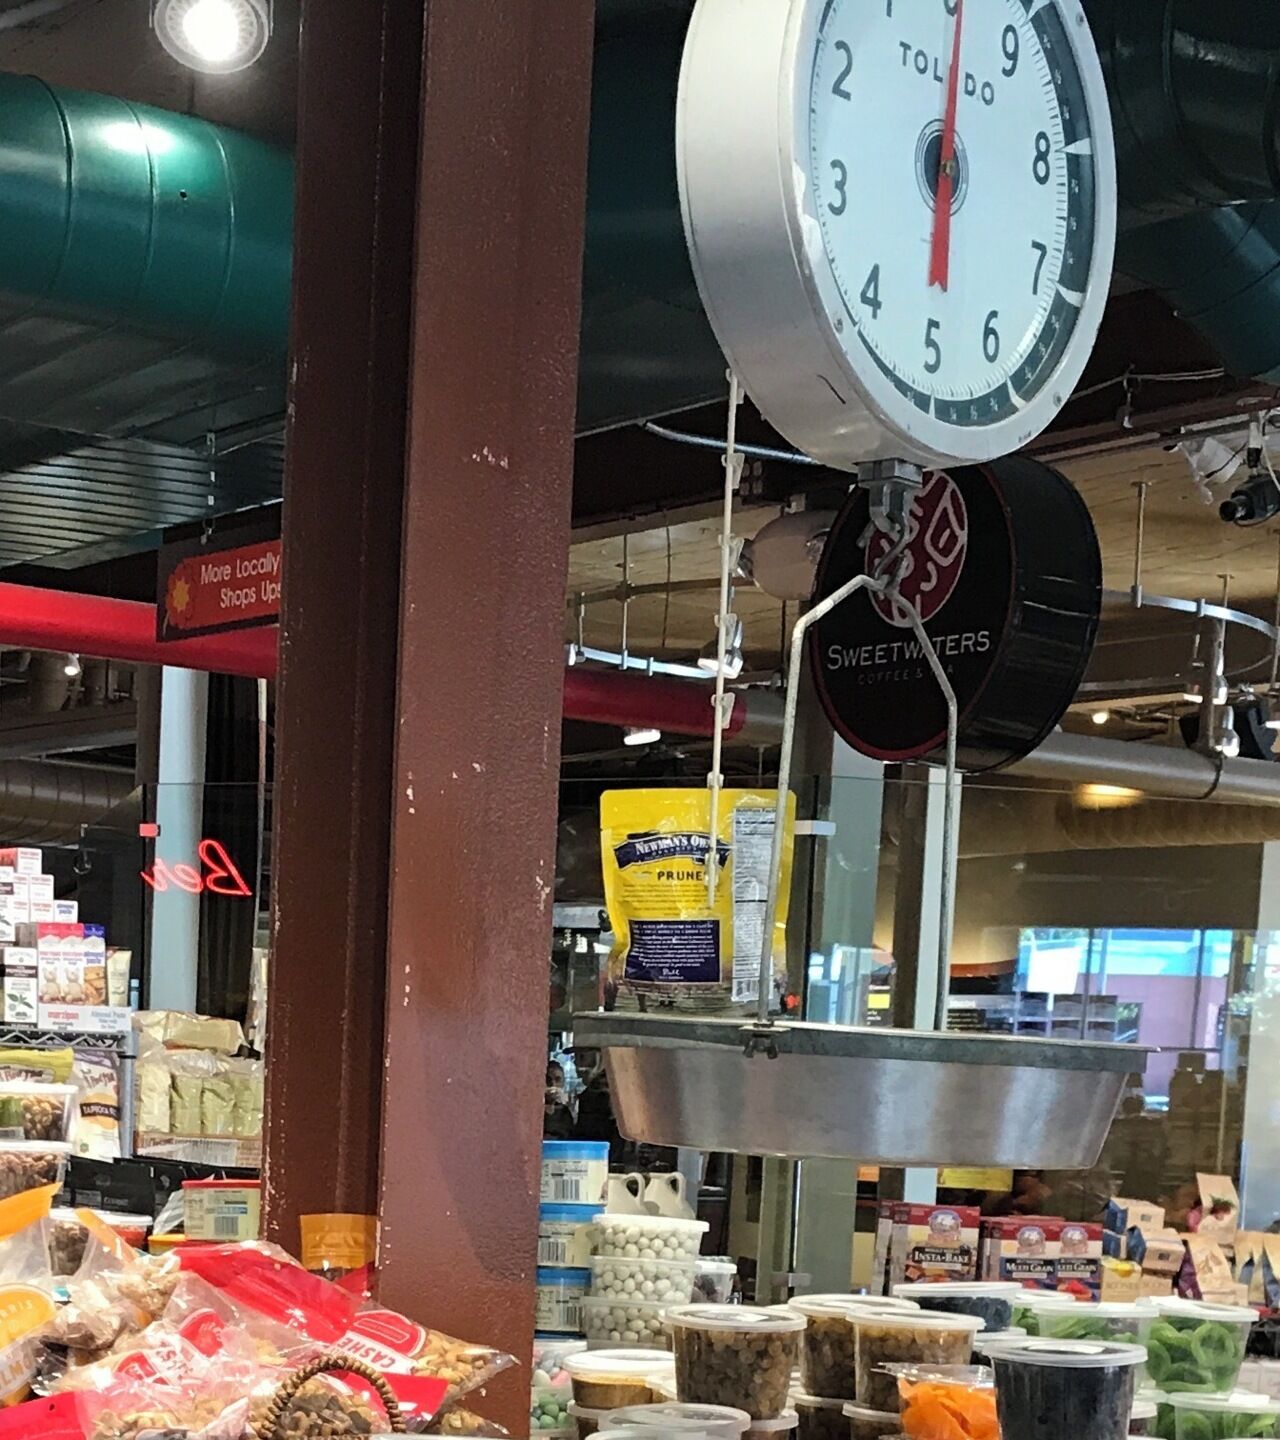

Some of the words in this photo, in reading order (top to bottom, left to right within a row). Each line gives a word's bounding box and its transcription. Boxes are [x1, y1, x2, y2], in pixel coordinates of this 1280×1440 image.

[832, 40, 853, 101] 2
[899, 41, 995, 105] TOLDO
[1001, 25, 1019, 77] 9
[1032, 131, 1050, 185] 8
[827, 159, 848, 216] 3
[860, 264, 883, 319] 4
[1031, 240, 1048, 295] 7
[924, 318, 941, 374] 5
[982, 309, 1000, 363] 6
[201, 563, 231, 585] More
[236, 551, 281, 579] Locally
[220, 585, 257, 609] Shops
[857, 669, 910, 686] COFFEE
[690, 834, 712, 847] OW
[337, 1335, 396, 1370] CASHE
